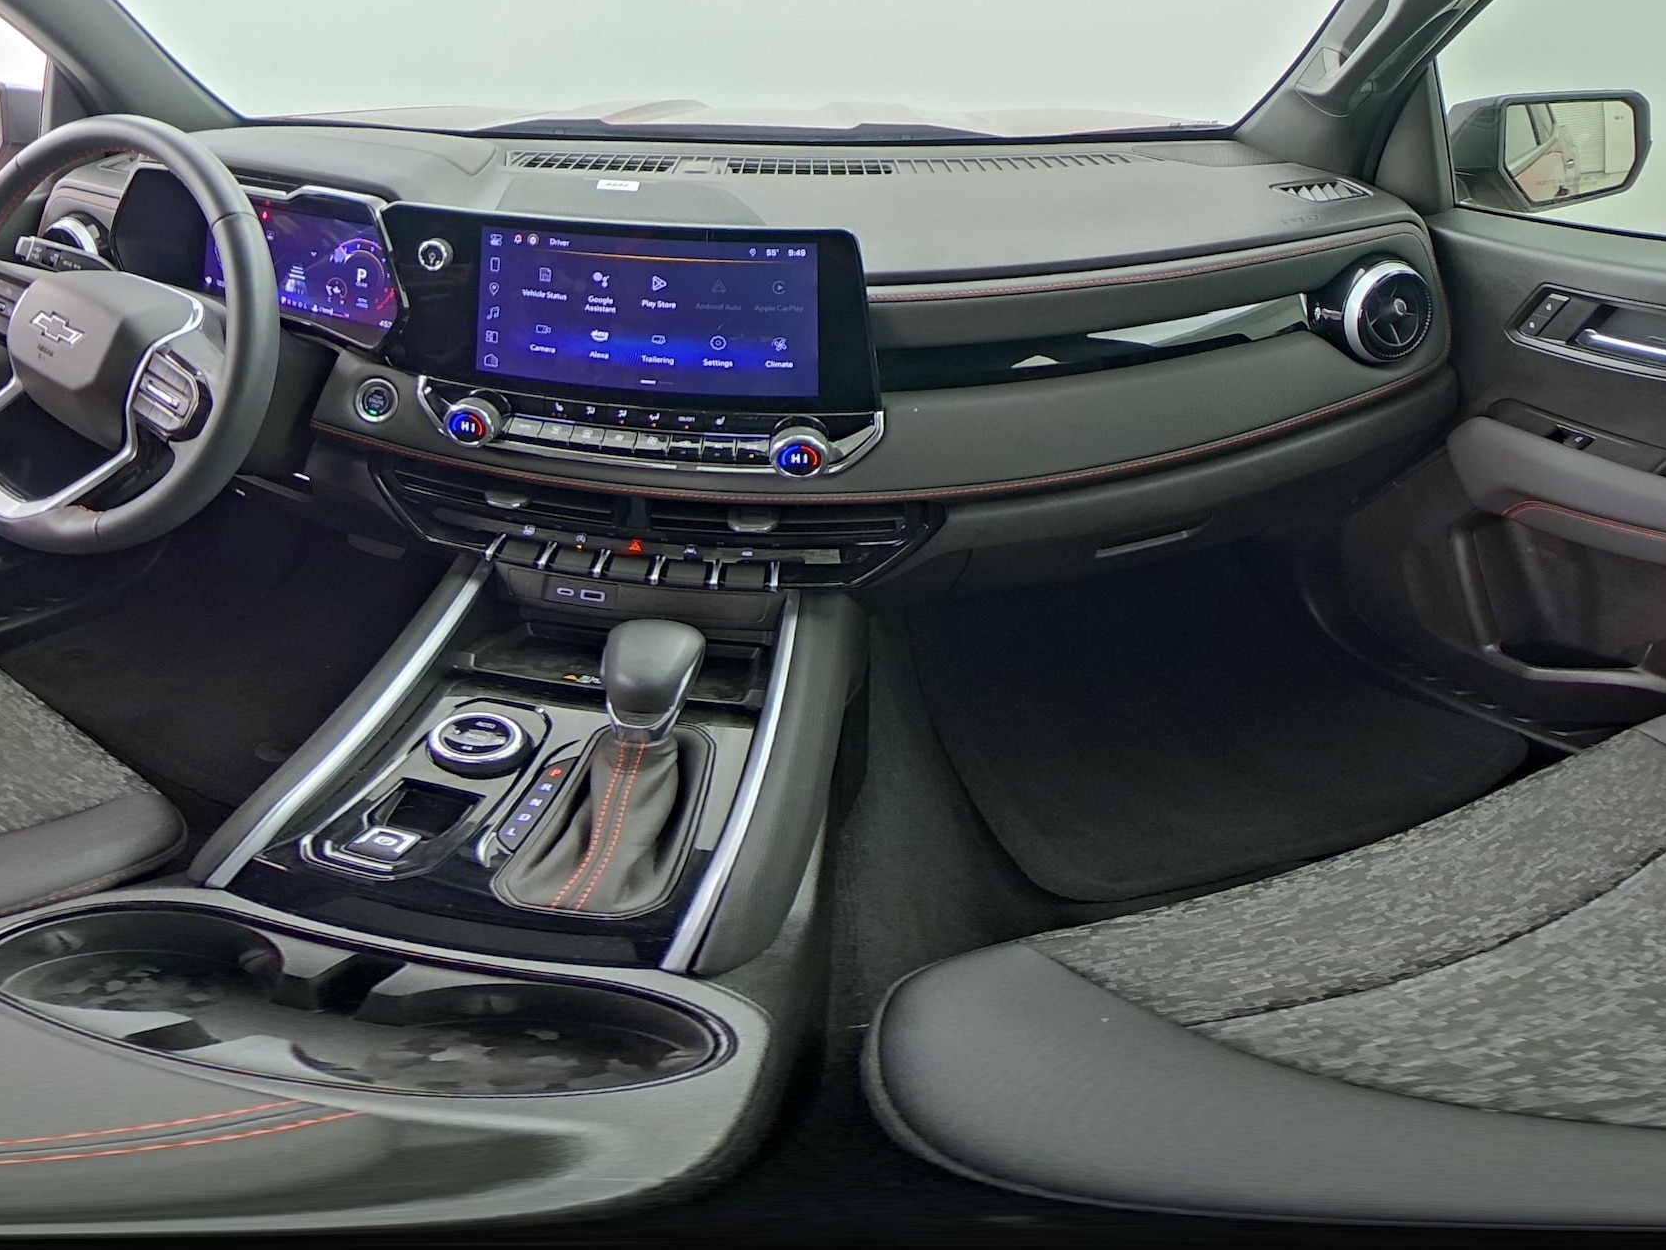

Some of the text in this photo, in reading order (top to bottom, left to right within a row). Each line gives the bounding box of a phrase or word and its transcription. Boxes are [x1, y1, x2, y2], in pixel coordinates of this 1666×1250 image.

[549, 238, 570, 247] Driver
[357, 268, 367, 282] P
[522, 288, 567, 301] Vehicle Status
[588, 295, 613, 305] Google
[641, 299, 676, 310] Play Store
[584, 304, 616, 314] Assistant
[695, 303, 742, 311] Android Auto
[754, 304, 804, 313] Apple CarPlay
[529, 344, 556, 354] Camera
[589, 351, 610, 360] Alexa
[641, 355, 675, 366] Trailering
[702, 358, 733, 369] Settings
[765, 361, 794, 369] Climate
[460, 421, 476, 433] HI
[790, 454, 808, 464] HI
[549, 769, 562, 777] P
[540, 783, 553, 791] R
[517, 813, 531, 821] D
[506, 828, 517, 836] L
